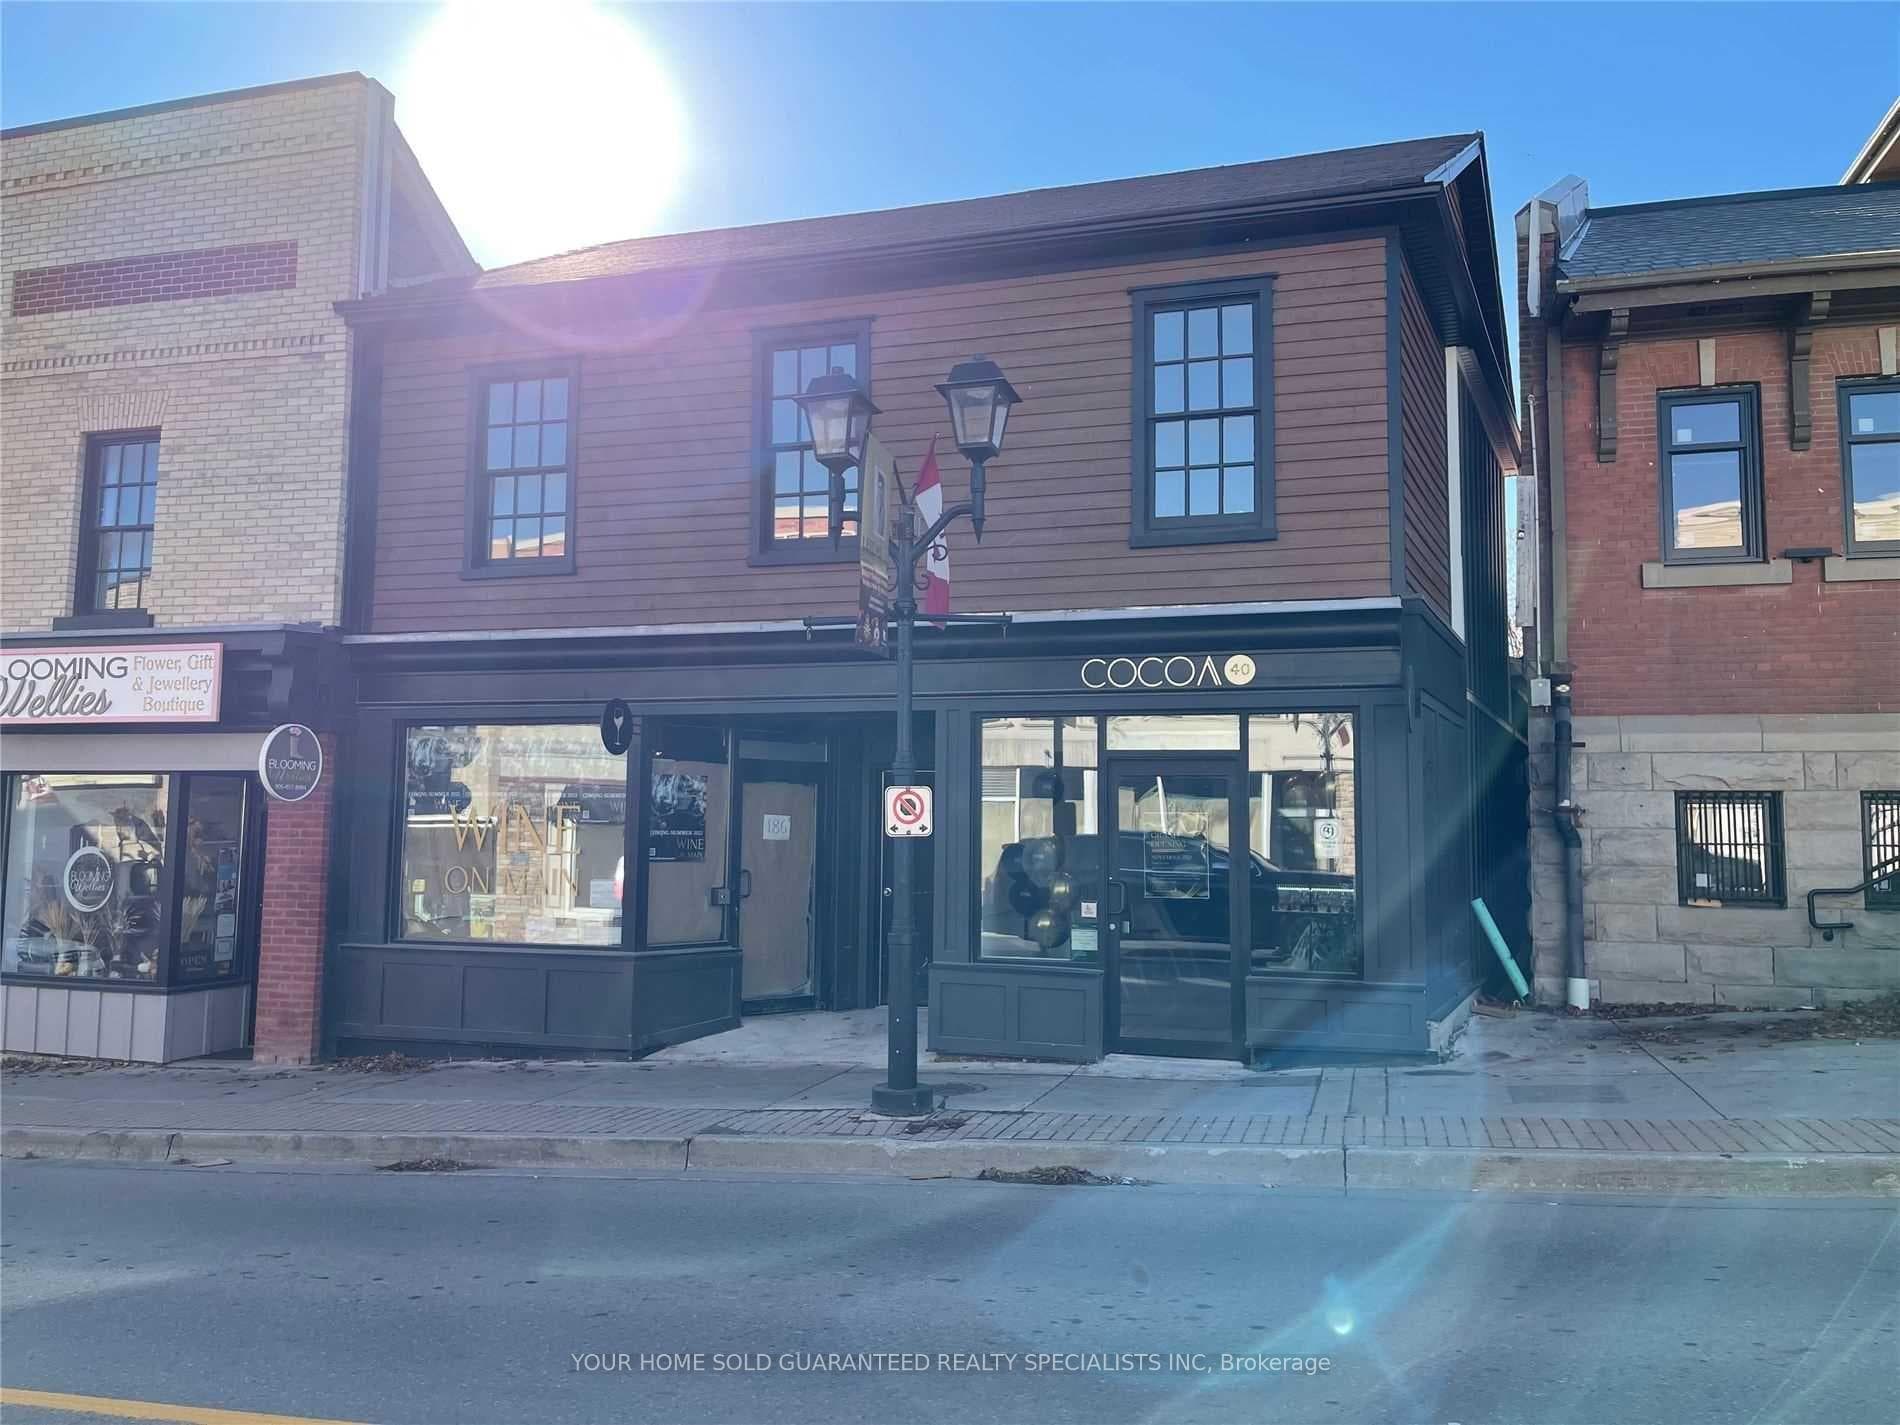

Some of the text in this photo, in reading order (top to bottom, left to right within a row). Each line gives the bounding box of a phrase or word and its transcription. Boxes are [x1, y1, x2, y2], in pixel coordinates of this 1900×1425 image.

[134, 654, 215, 673] Flower, Gift
[1081, 655, 1250, 688] COCOA 40
[132, 676, 144, 691] &
[144, 696, 205, 714] Boutique
[268, 758, 317, 771] BLOOMING
[450, 802, 581, 854] WINE
[676, 838, 704, 850] WINE
[445, 866, 490, 894] ON
